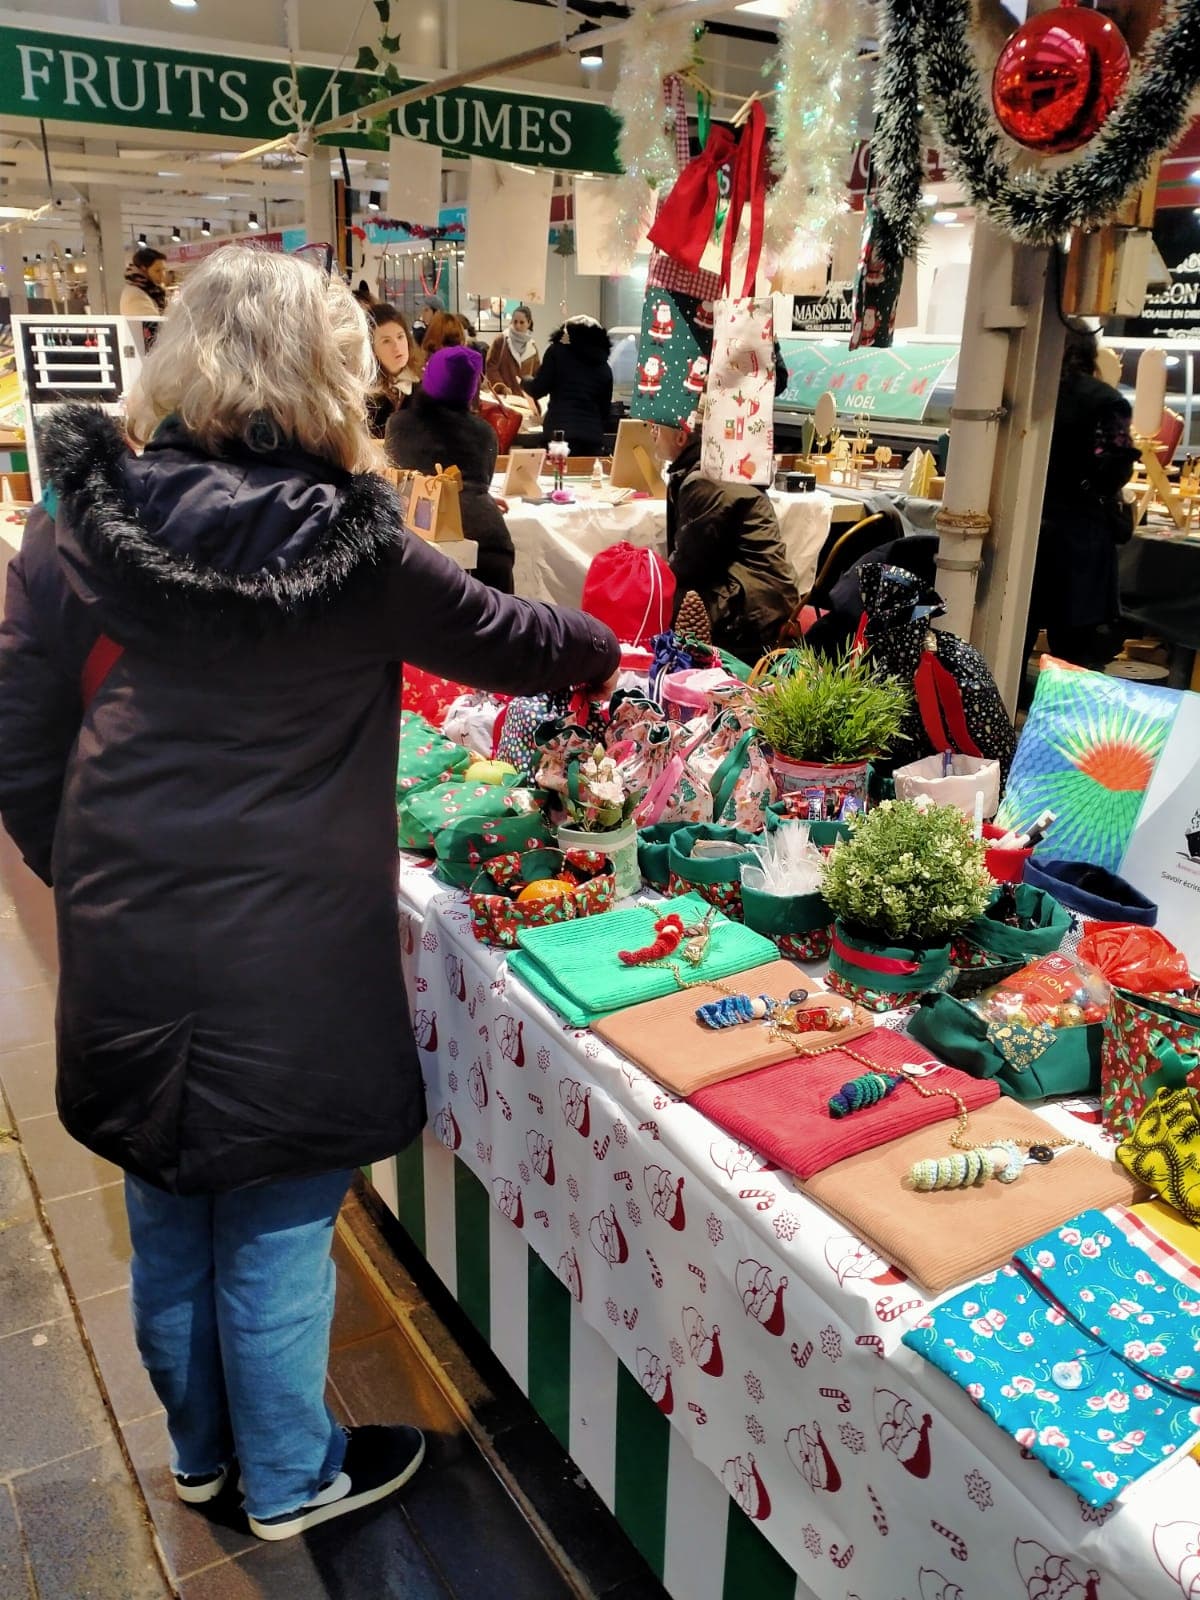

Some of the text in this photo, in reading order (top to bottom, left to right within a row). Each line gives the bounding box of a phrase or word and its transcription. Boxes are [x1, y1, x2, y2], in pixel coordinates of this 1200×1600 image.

[16, 45, 249, 122] FRUITS
[267, 76, 307, 126] &
[794, 303, 838, 321] MAISON
[1161, 871, 1183, 885] Savoir
